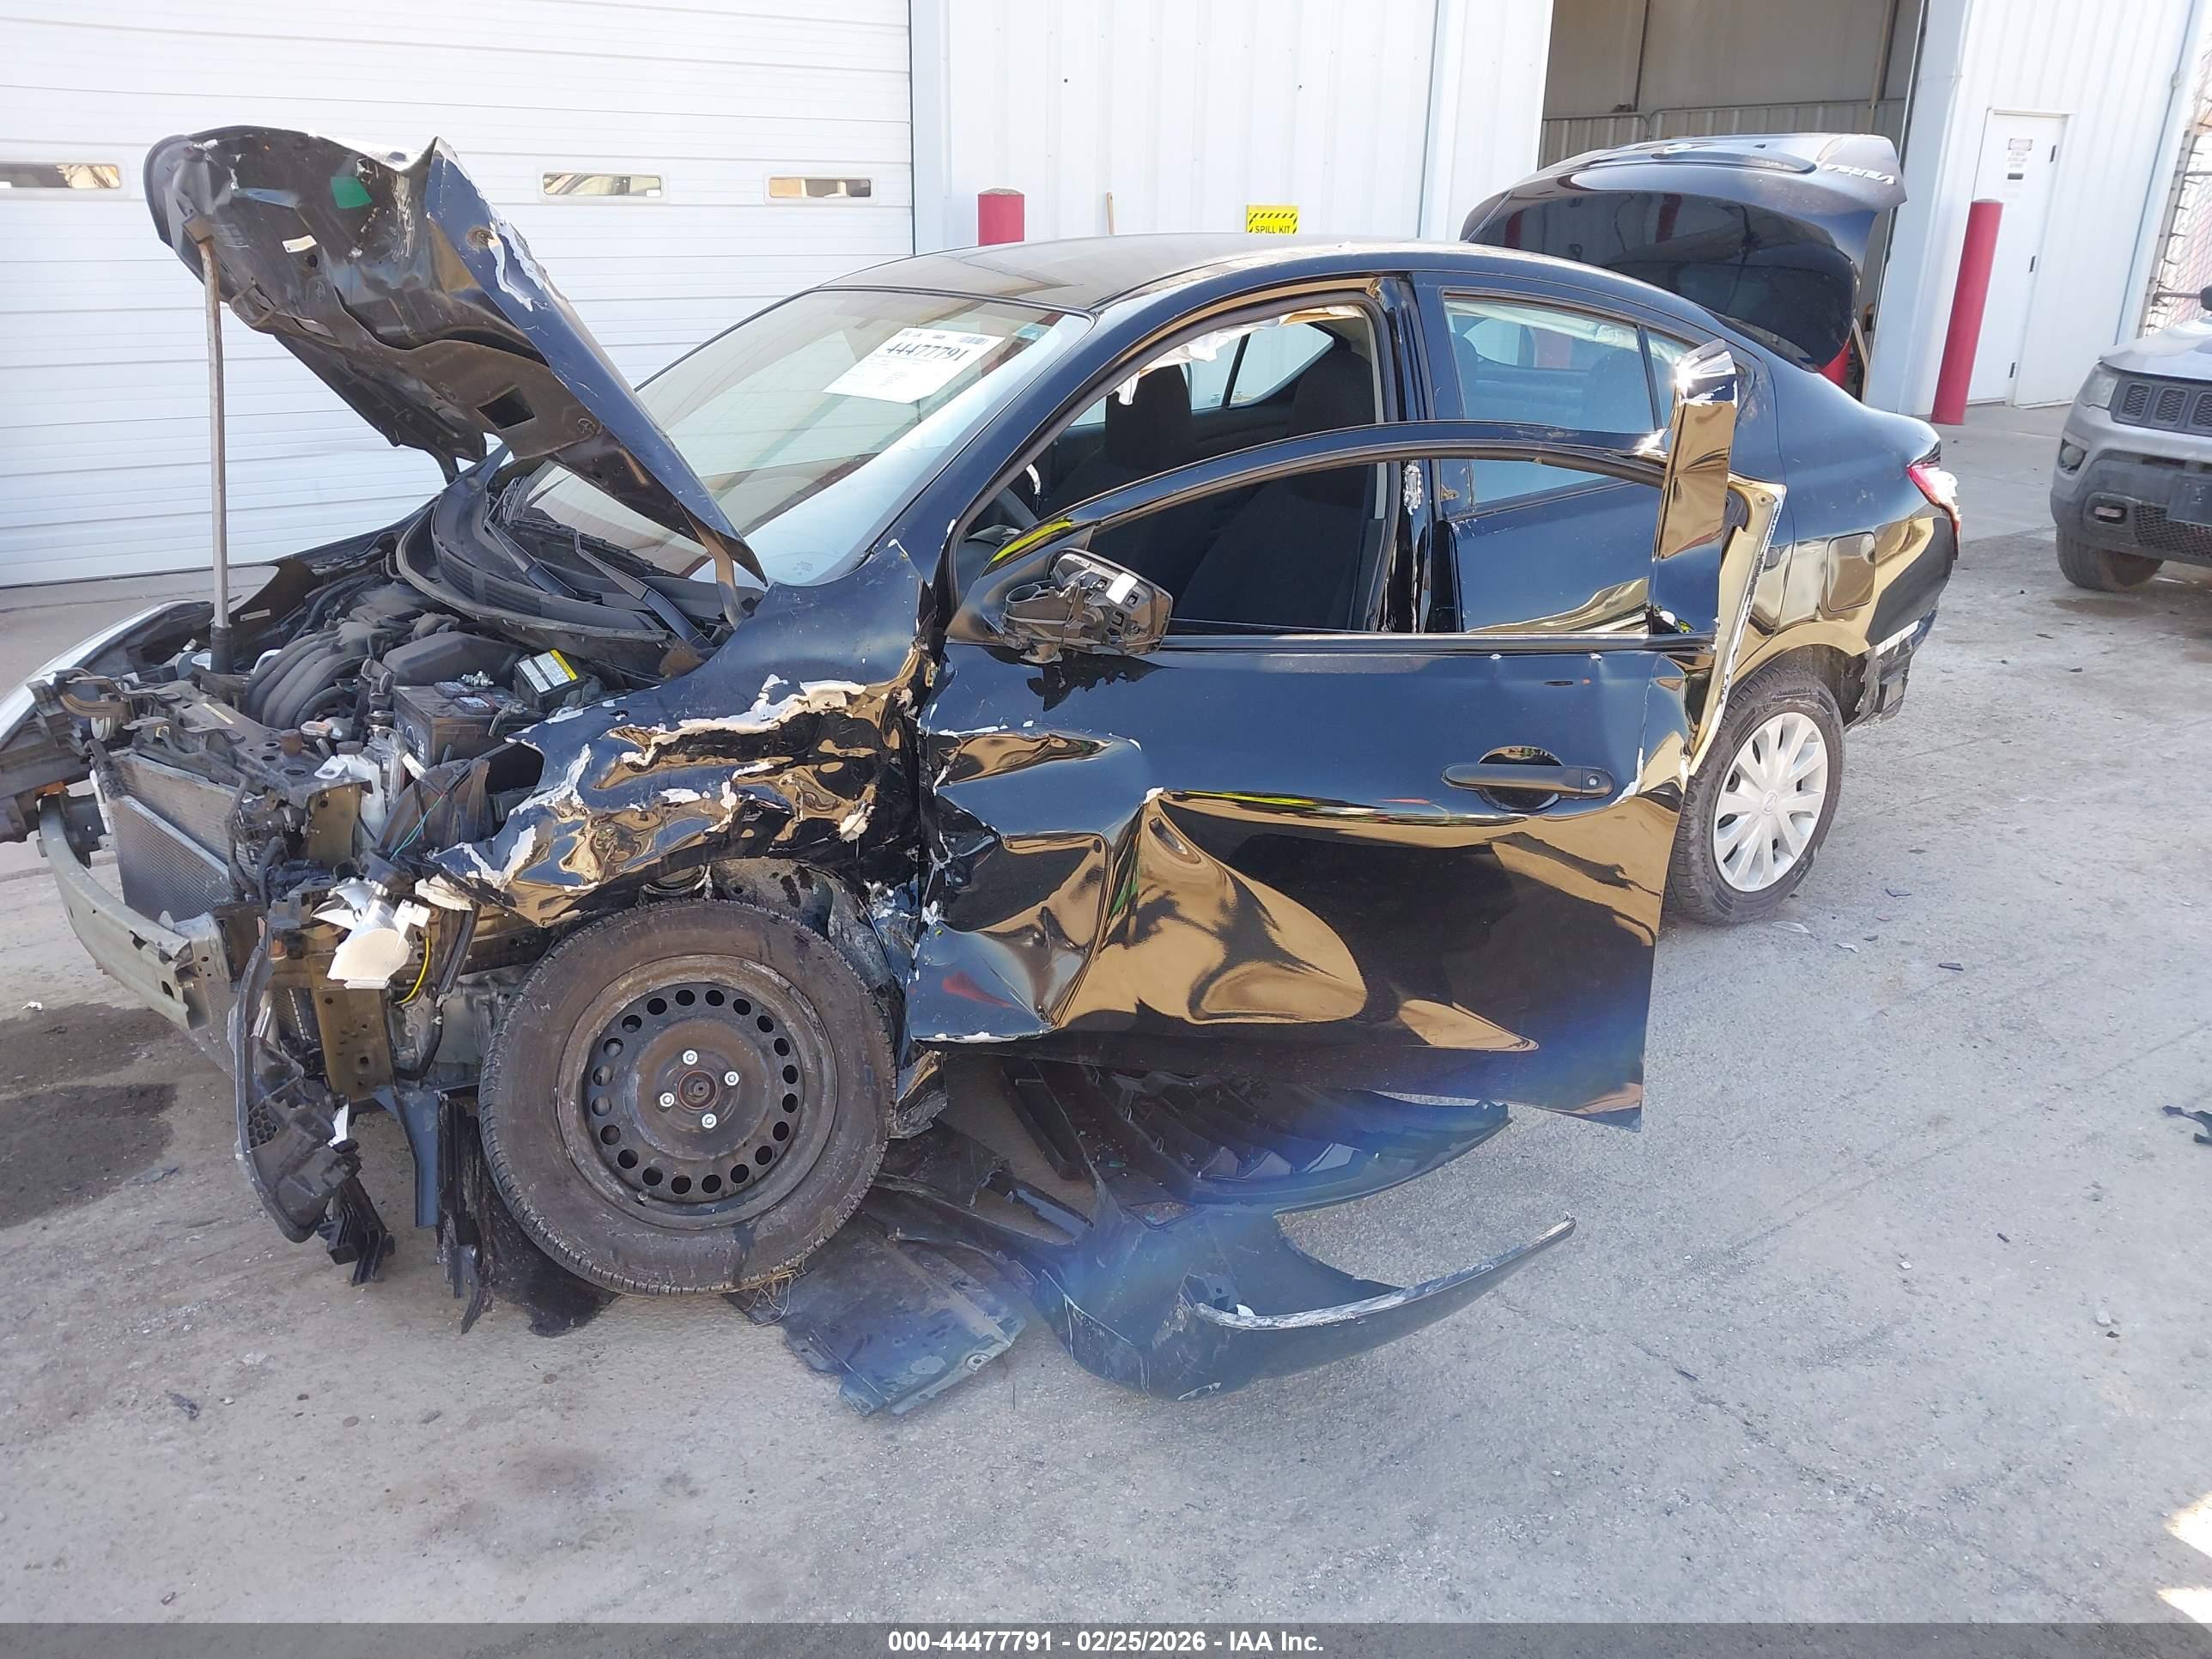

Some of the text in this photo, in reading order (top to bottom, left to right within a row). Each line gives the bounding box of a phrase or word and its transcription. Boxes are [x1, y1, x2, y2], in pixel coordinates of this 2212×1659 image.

[1255, 225, 1291, 234] SPILL KIT
[886, 343, 970, 362] 44477791
